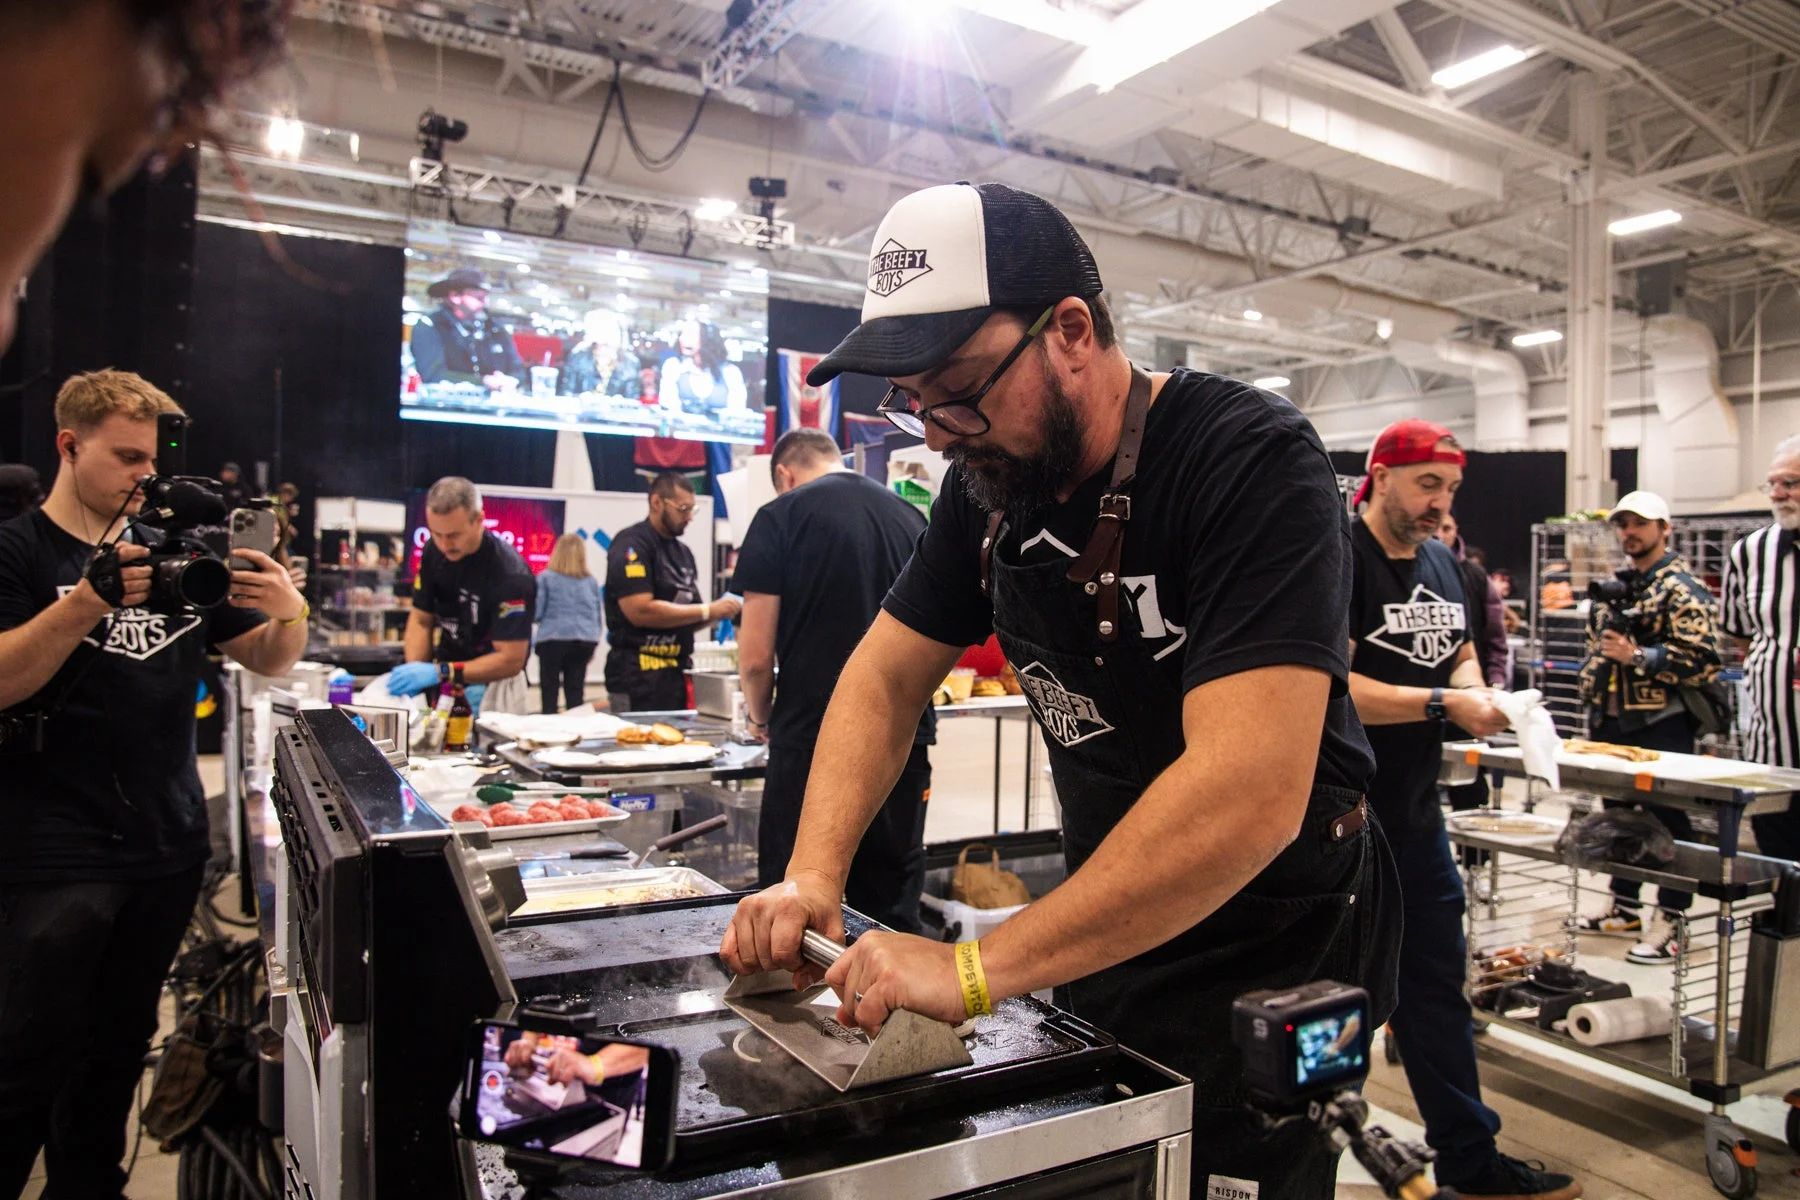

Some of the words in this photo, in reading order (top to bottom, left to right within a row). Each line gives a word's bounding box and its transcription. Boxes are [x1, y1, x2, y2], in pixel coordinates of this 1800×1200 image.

[885, 251, 925, 270] BEEFY
[876, 270, 904, 292] BOYS
[1411, 630, 1452, 660] OYS
[1040, 681, 1095, 720] BEEFY
[1039, 701, 1080, 742] BOYS
[1215, 1187, 1251, 1200] RISDON
